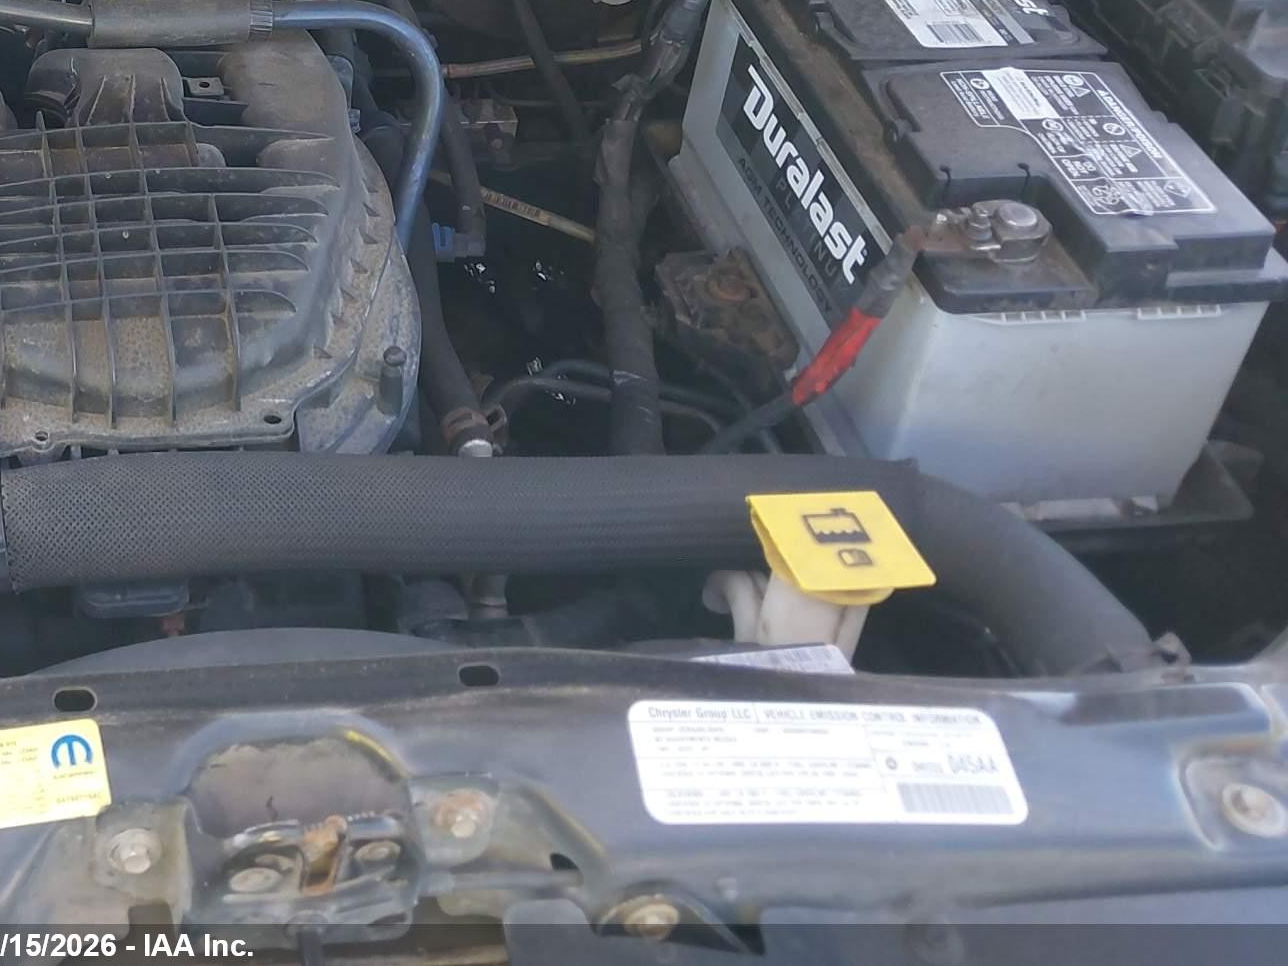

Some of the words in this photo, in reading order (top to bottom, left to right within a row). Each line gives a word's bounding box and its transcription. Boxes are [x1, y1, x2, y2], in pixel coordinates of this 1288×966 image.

[743, 64, 865, 284] Duralast
[648, 706, 692, 721] Chrysler
[696, 707, 727, 721] Group
[730, 708, 751, 720] LLC
